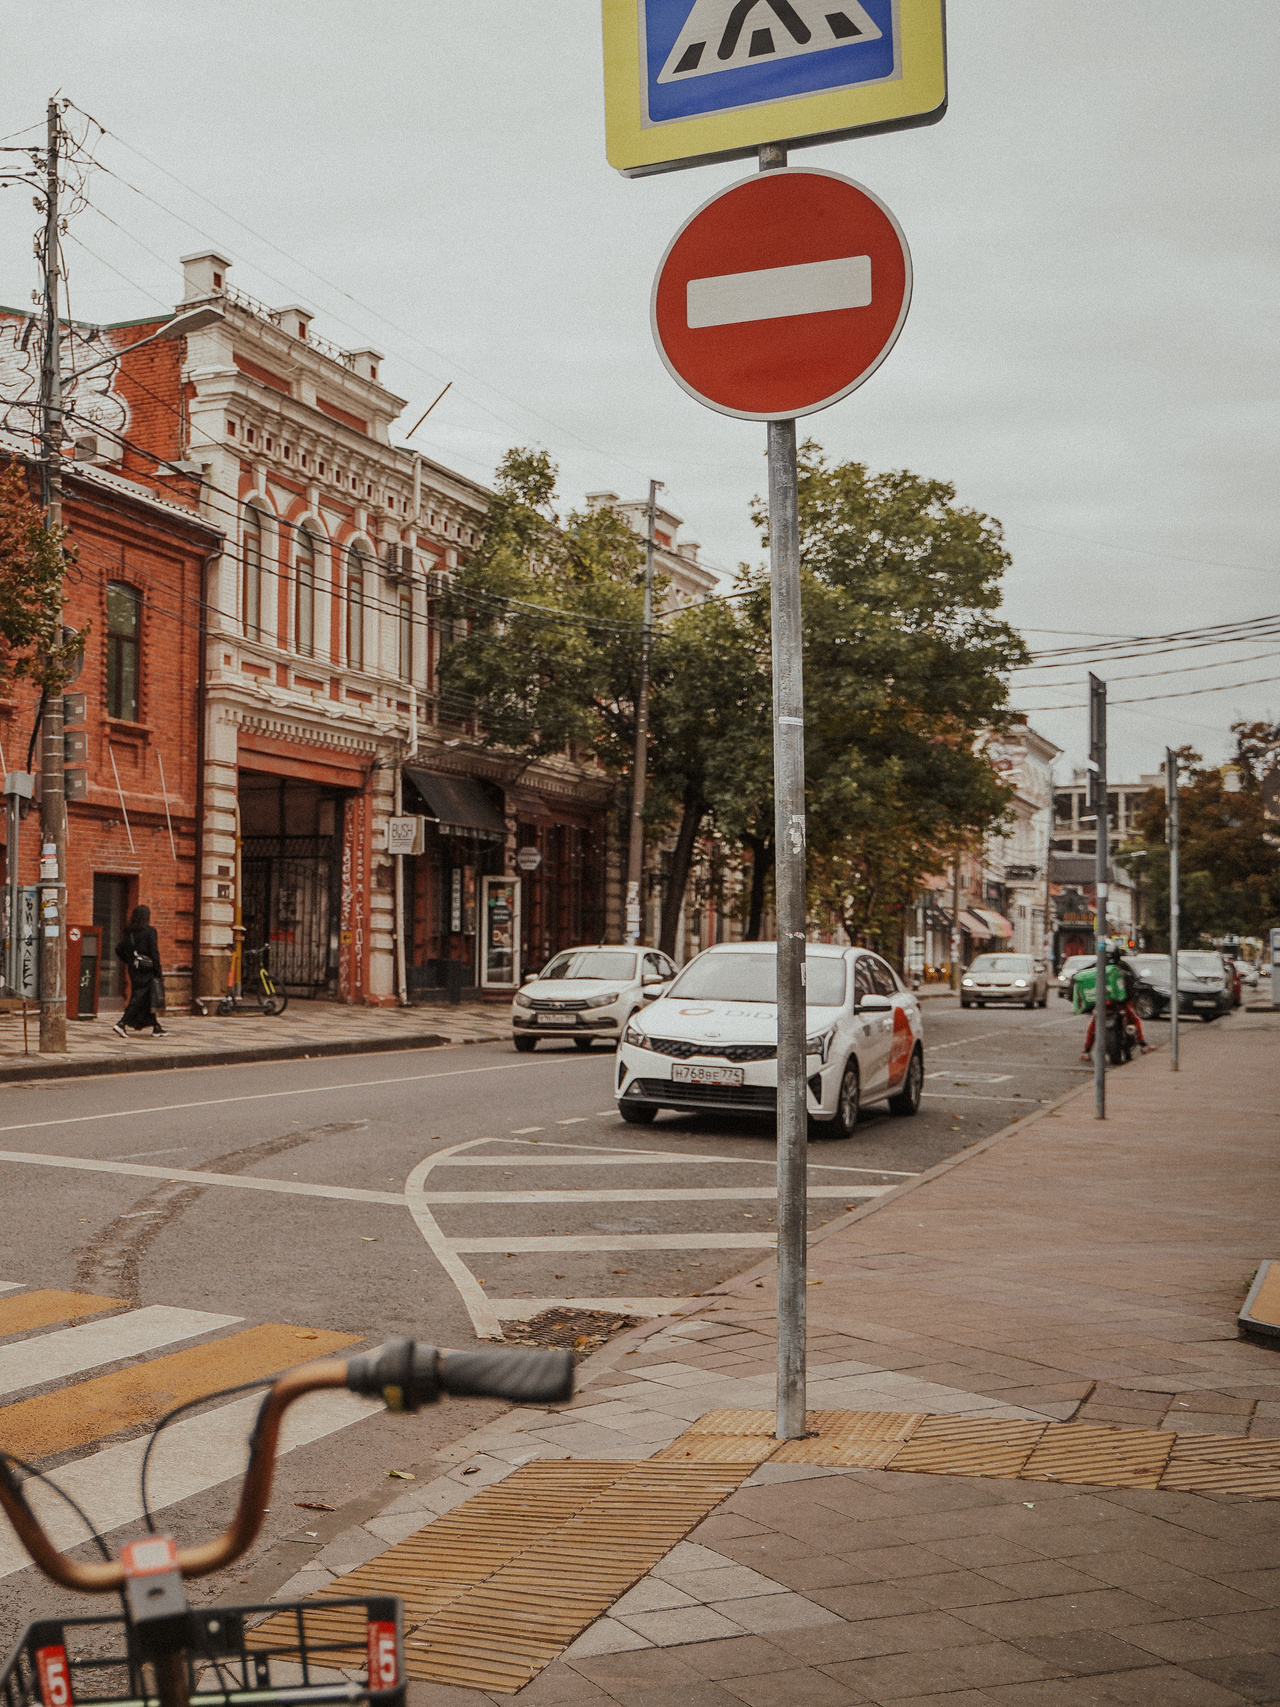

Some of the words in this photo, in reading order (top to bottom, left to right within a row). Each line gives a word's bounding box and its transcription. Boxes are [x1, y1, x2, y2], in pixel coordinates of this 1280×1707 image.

[391, 823, 413, 838] BUSH
[378, 1639, 396, 1683] 5
[46, 1663, 68, 1705] 5
